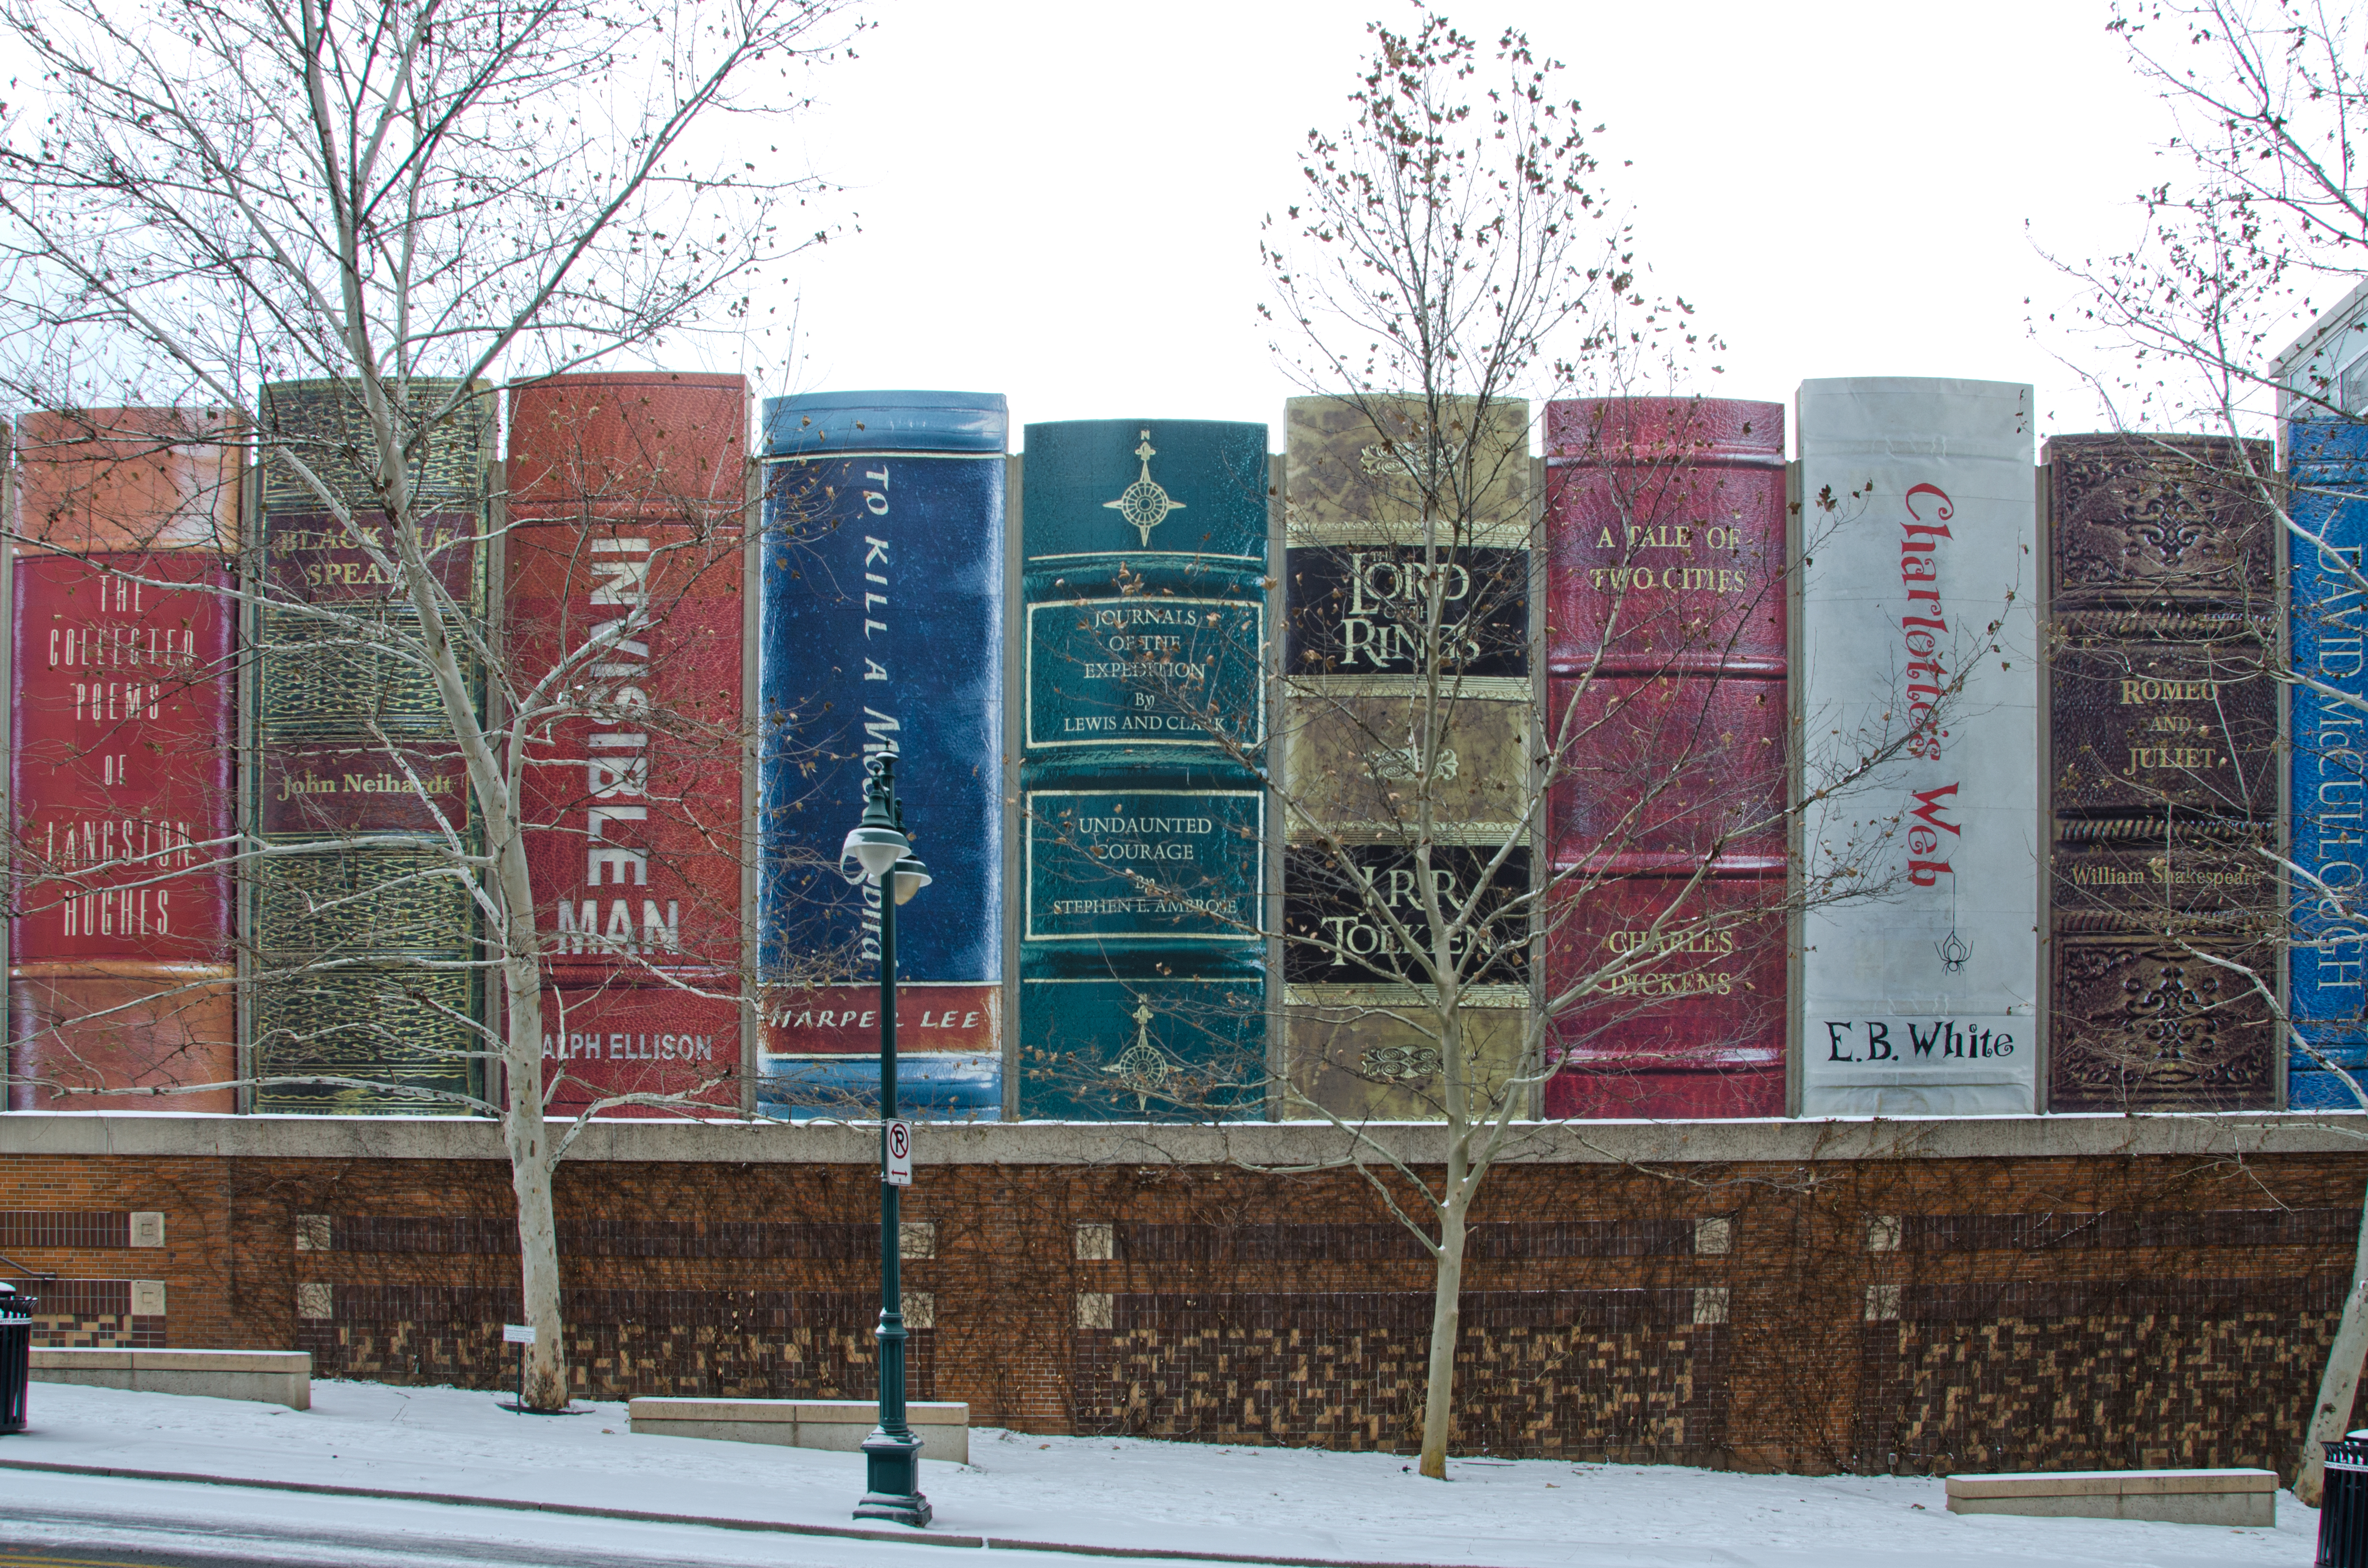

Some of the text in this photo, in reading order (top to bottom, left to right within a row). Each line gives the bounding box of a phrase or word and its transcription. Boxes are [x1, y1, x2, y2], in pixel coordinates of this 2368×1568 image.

[865, 465, 888, 515] TO
[392, 527, 455, 548] LK
[1596, 526, 1741, 550] A TALE OF
[306, 563, 397, 587] SPEA
[865, 535, 889, 641] KILL
[1348, 552, 1470, 614] LORD
[1590, 567, 1747, 592] TWO CITIES
[99, 575, 144, 612] THE
[1095, 610, 1196, 627] JOURNALS
[2318, 543, 2363, 679] DAVID
[49, 628, 194, 666] COLLECTED
[1109, 636, 1181, 651] OF THE
[864, 657, 888, 695] A
[1084, 662, 1206, 679] EXPEDITION
[1899, 482, 1961, 887] Charlotte's Web
[77, 682, 160, 720] POEMS
[1135, 692, 1155, 711] By
[2119, 679, 2220, 705] ROMEO
[588, 537, 650, 886] INVISIBLE
[1064, 716, 1117, 732] LEWIS
[1122, 716, 1162, 731] AND
[2148, 716, 2192, 732] AND
[105, 754, 127, 785] OF
[2123, 748, 2217, 776] JULIET
[277, 773, 454, 801] John Neihadt
[1079, 818, 1212, 834] UNDAUNTED
[46, 819, 191, 867] LANGSTON
[1098, 844, 1194, 860] COURAGE
[2072, 864, 2261, 886] William Shakespeare
[63, 889, 169, 936] HUGHES
[1053, 899, 1237, 915] STEPHEN E. AMBROSE
[557, 899, 679, 955] MAN
[1320, 916, 1494, 966] TOLKEN
[1609, 931, 1733, 954] CHARLES
[1611, 972, 1731, 995] DICKENS
[920, 1010, 980, 1029] LEE
[541, 1033, 712, 1061] ALPH ELLISON
[1907, 1019, 2015, 1059] White
